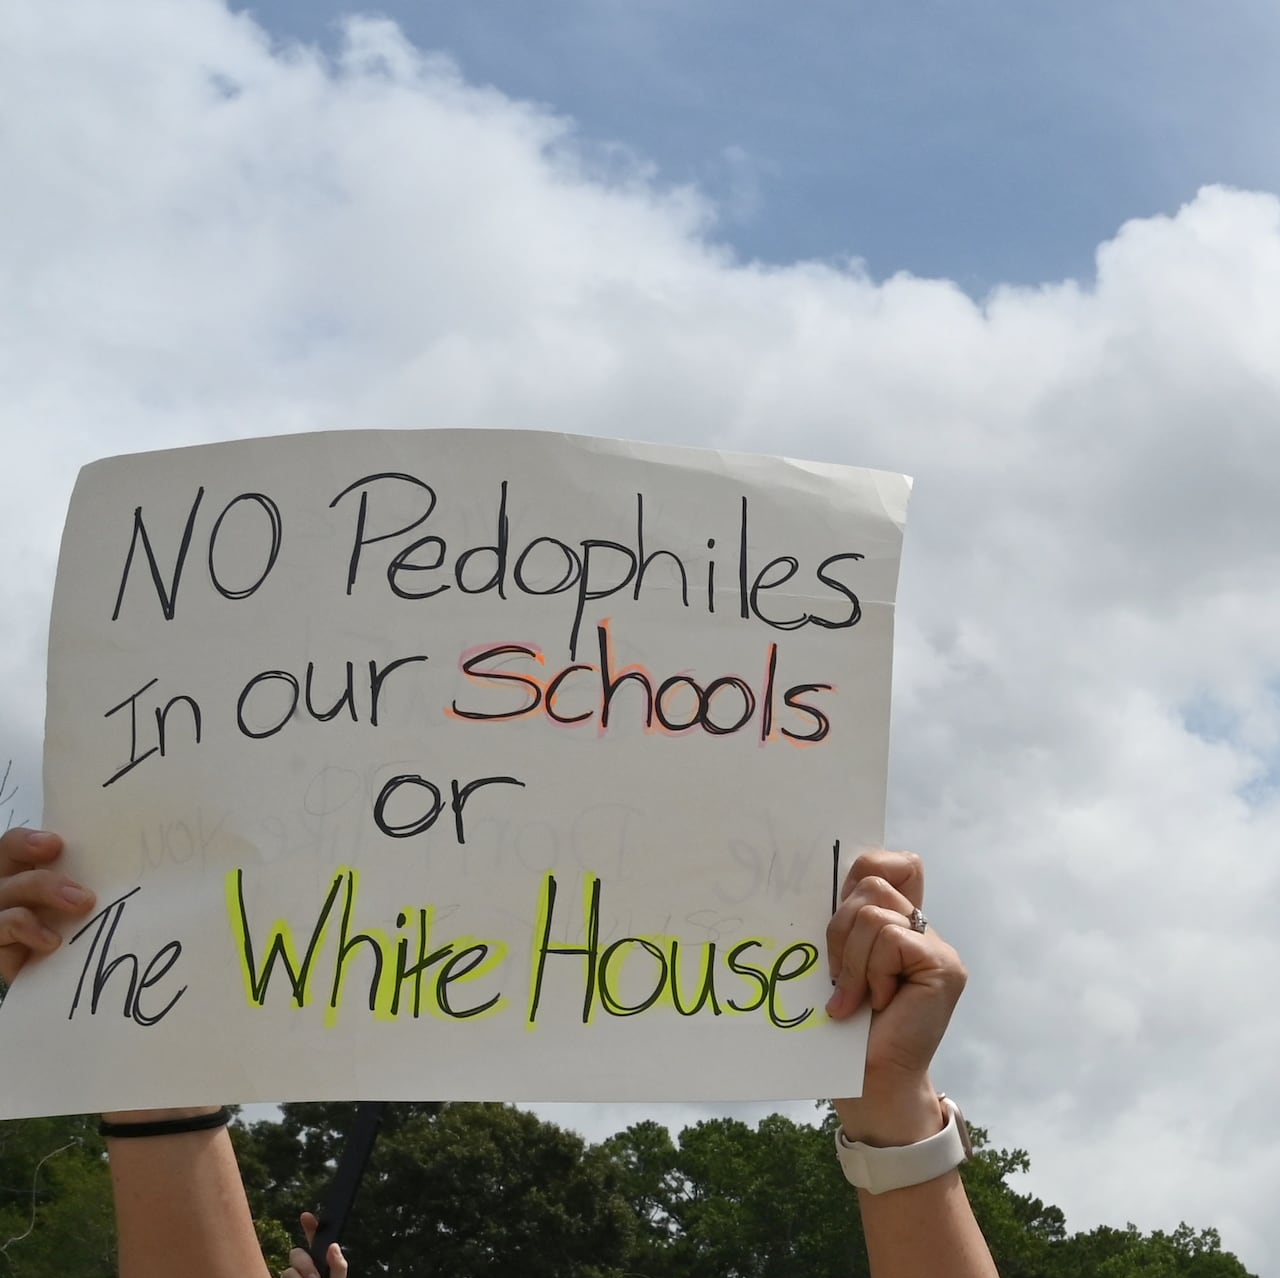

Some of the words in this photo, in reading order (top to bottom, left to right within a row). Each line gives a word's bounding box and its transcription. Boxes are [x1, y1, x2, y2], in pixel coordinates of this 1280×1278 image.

[111, 486, 282, 621] NO
[328, 472, 867, 661] Pedophiles
[102, 678, 202, 788] In
[236, 655, 428, 740] our
[444, 618, 834, 748] Schools
[373, 773, 526, 844] or
[68, 886, 188, 1026] The
[225, 865, 507, 1027] White
